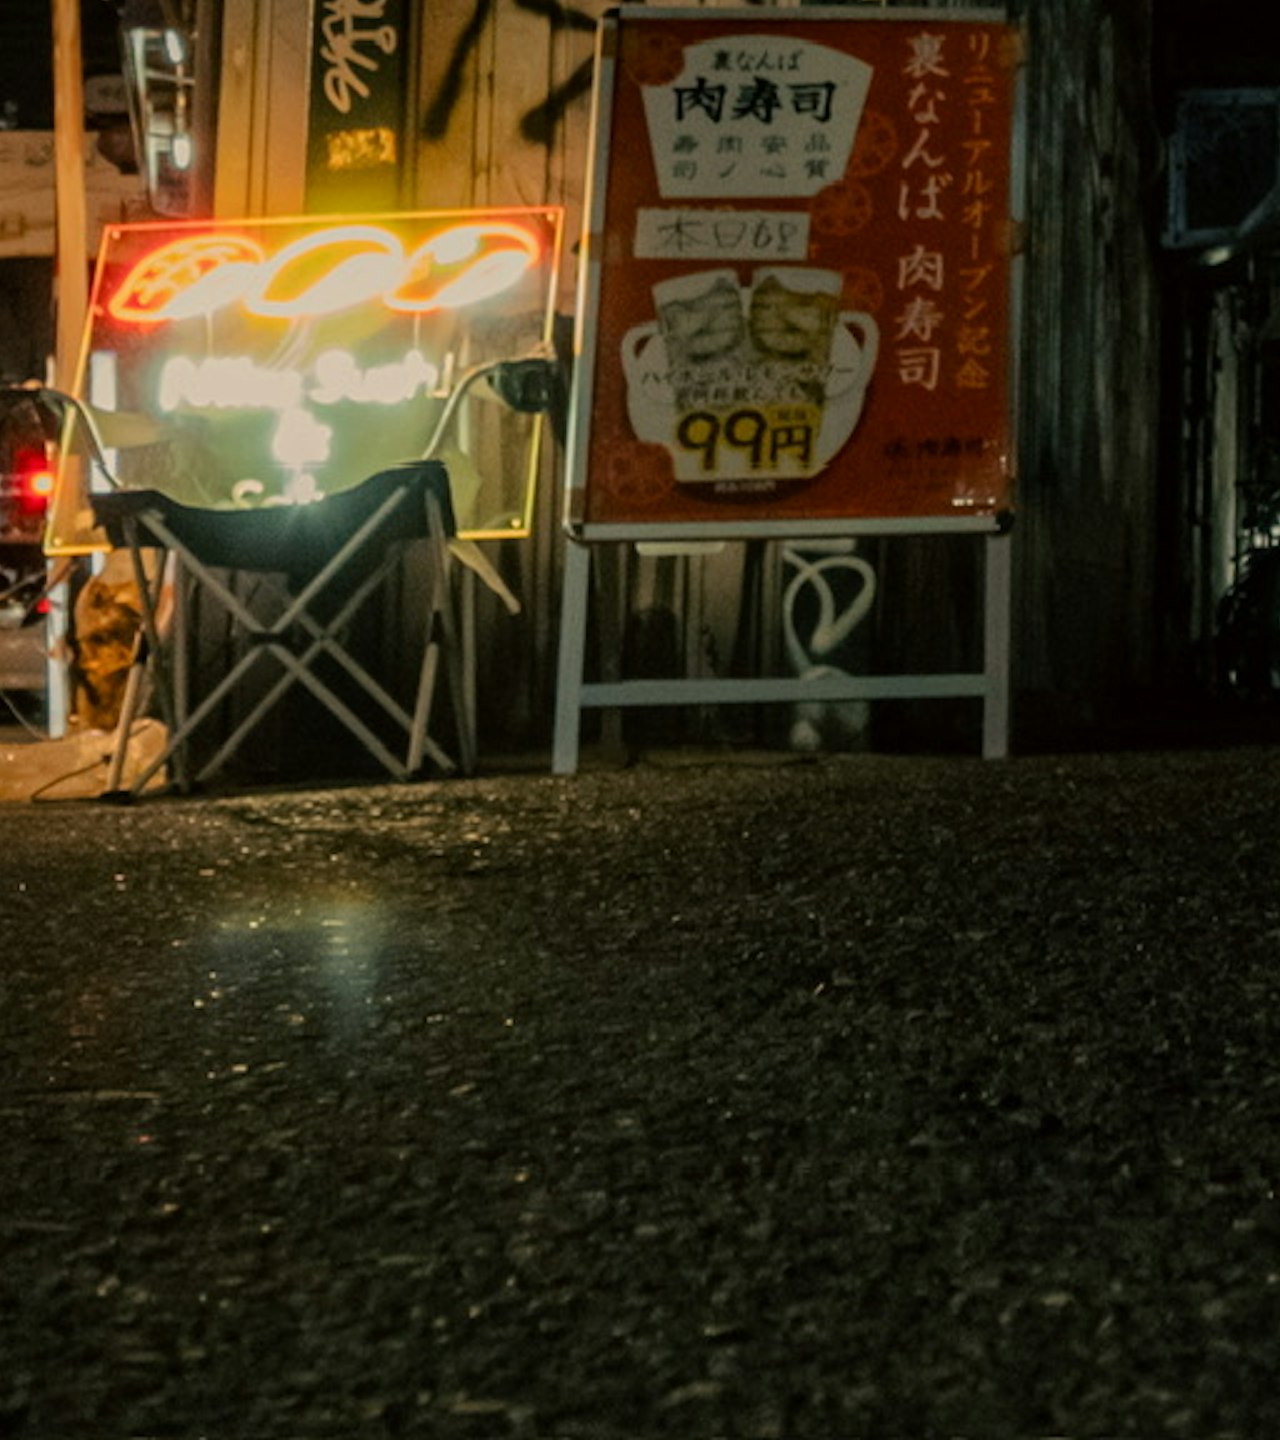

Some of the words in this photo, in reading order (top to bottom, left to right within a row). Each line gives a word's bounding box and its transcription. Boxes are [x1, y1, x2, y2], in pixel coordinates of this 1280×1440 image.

[714, 48, 803, 71] 裏なんば
[673, 76, 836, 123] 肉寿司
[898, 30, 954, 222] 裏なんば
[894, 243, 946, 392] 肉寿司
[677, 410, 813, 469] 99円
